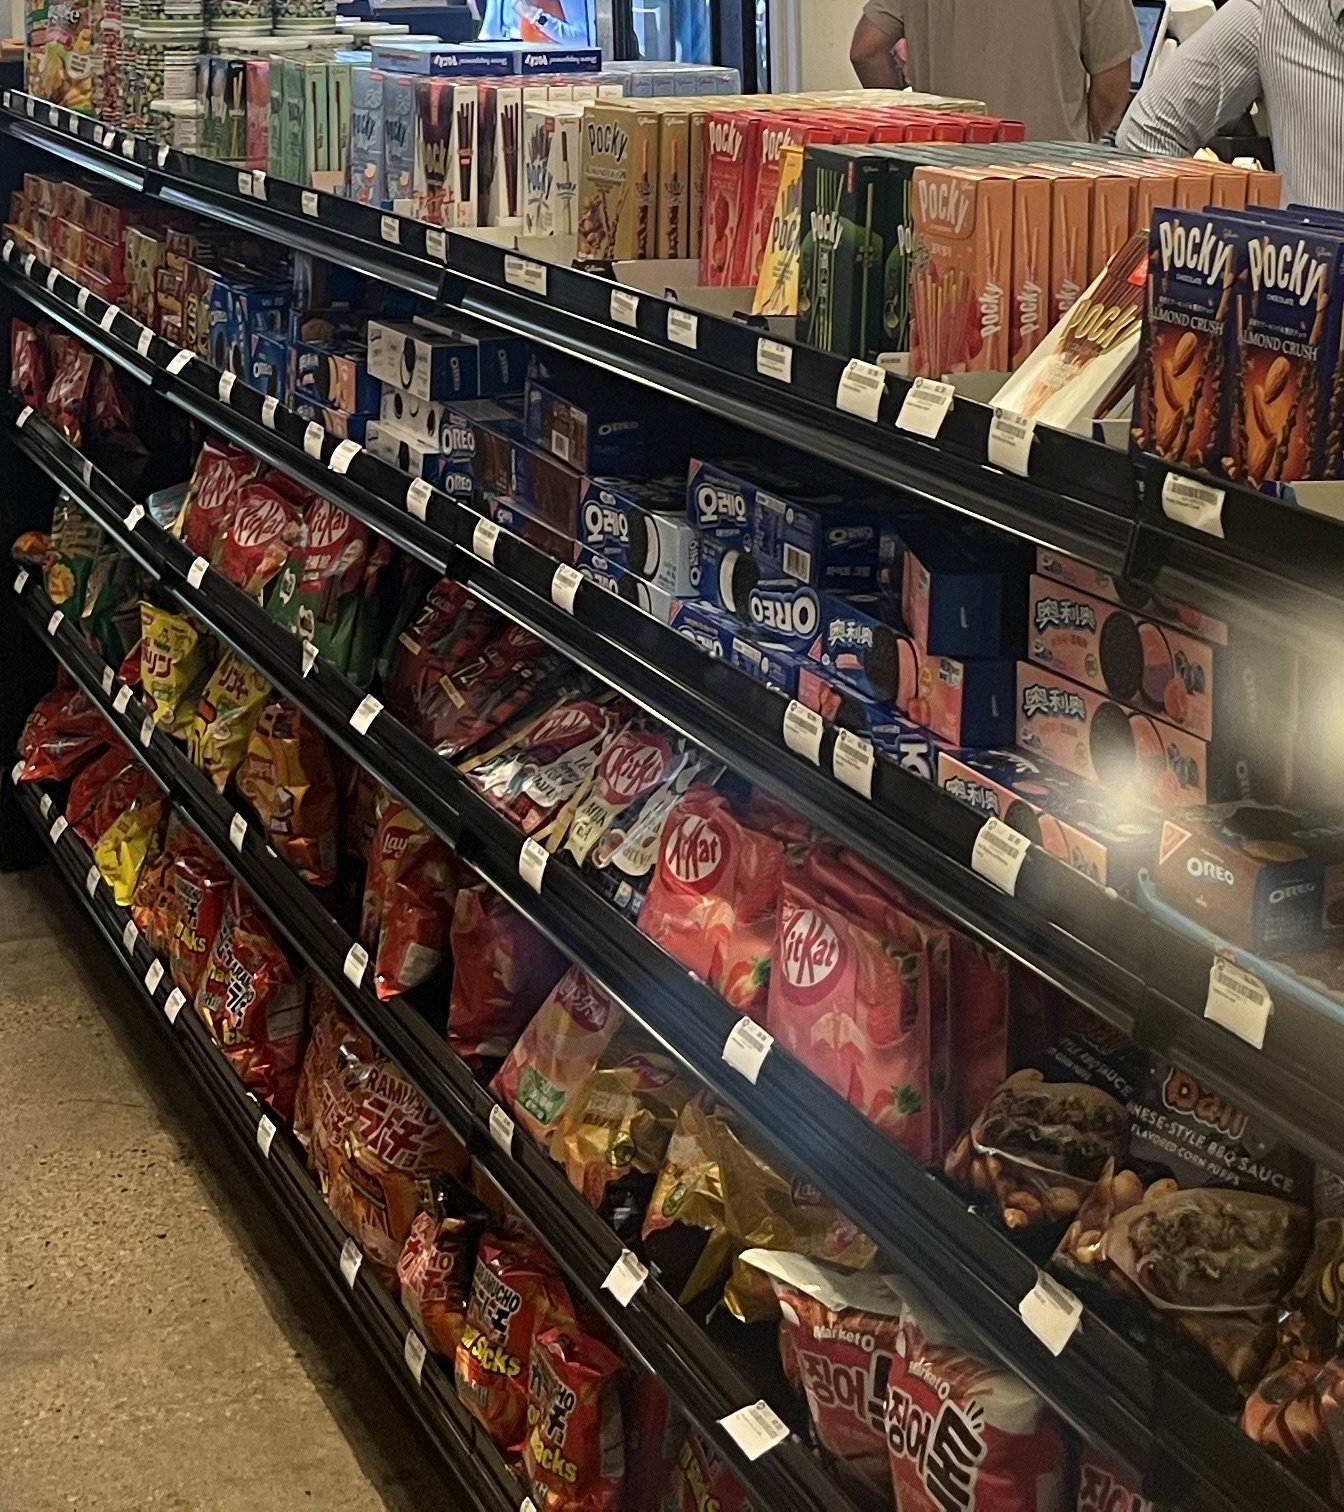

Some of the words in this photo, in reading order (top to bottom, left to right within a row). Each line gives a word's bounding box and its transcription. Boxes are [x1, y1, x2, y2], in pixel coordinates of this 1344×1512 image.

[1148, 305, 1190, 329] ALMOND
[1189, 315, 1225, 336] CRUSH
[1238, 328, 1282, 353] ALMOND
[1281, 340, 1319, 362] CRUSH
[442, 426, 476, 454] OREO
[445, 474, 472, 493] OREO
[697, 486, 747, 526] 오레오
[584, 504, 630, 544] 오레오
[1186, 857, 1235, 886] OREO
[1268, 882, 1317, 905] OREO
[1207, 1141, 1237, 1168] BBQ
[1237, 1157, 1294, 1193] SAUCE
[1207, 1159, 1241, 1187] PUFFS
